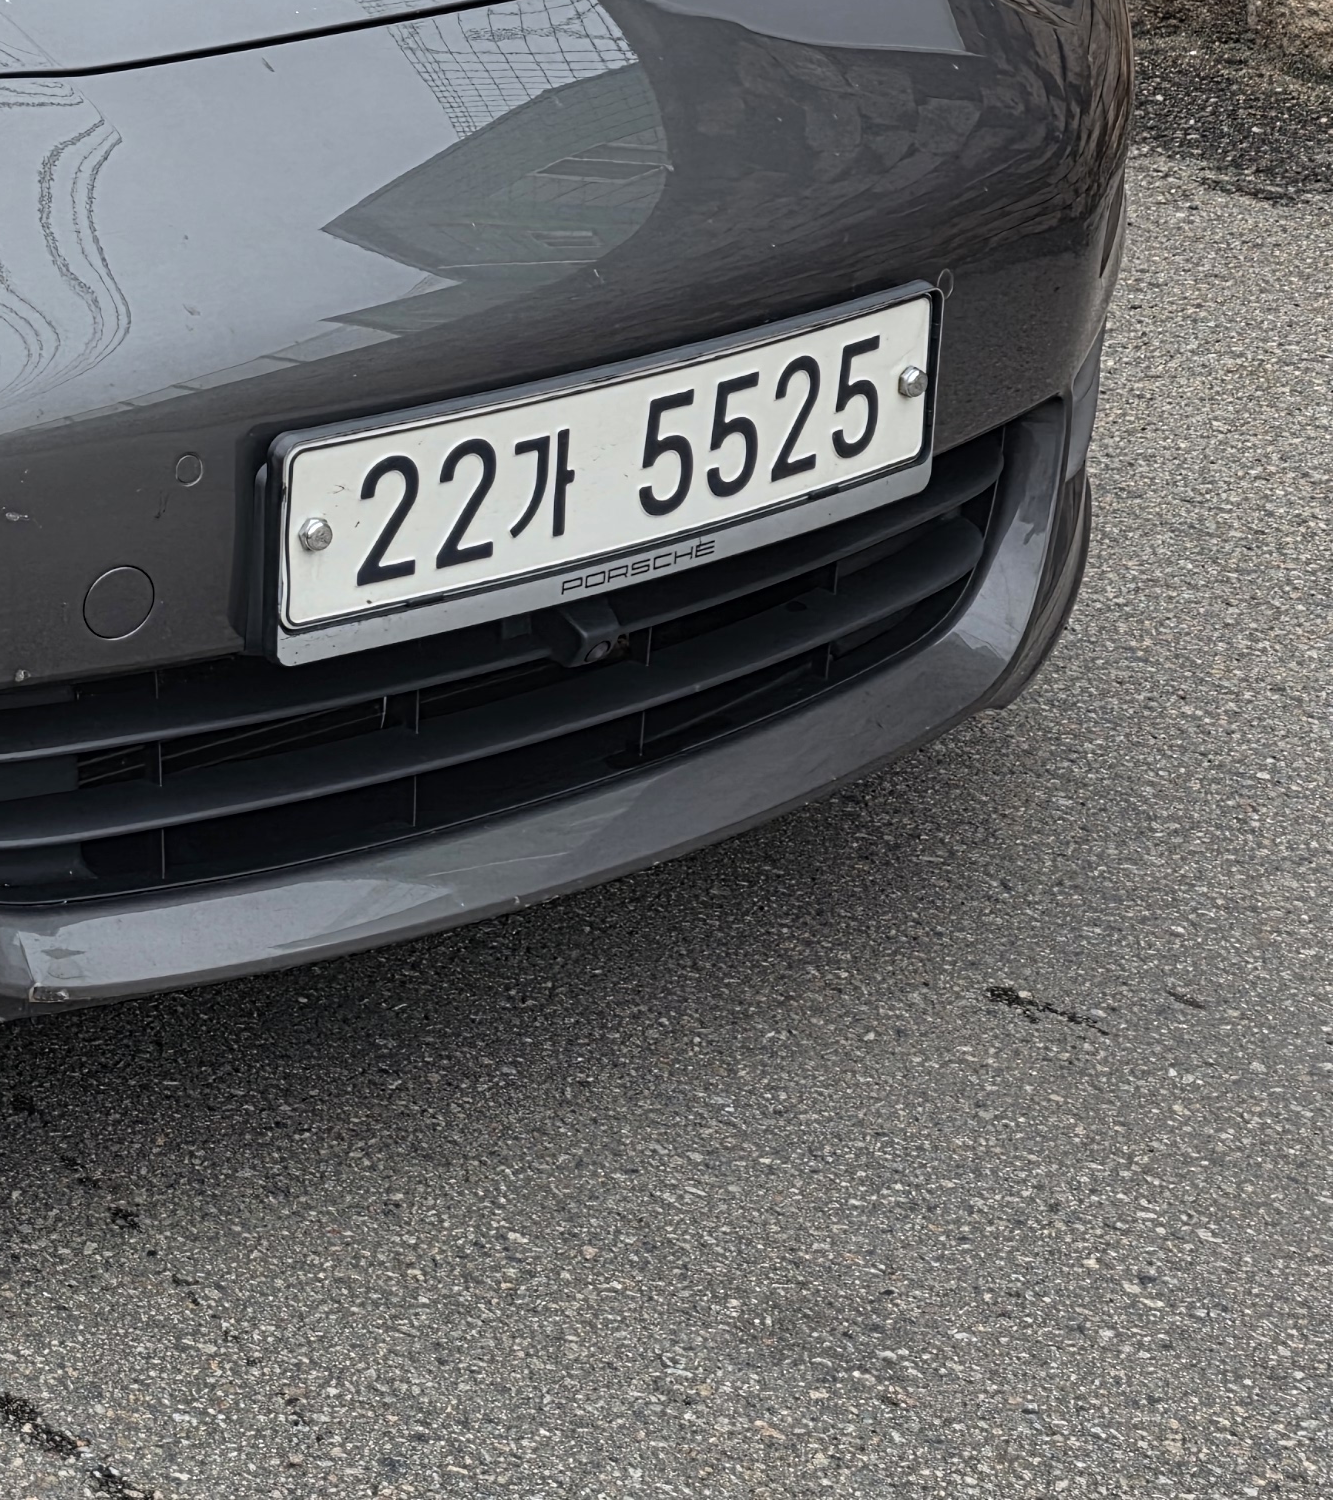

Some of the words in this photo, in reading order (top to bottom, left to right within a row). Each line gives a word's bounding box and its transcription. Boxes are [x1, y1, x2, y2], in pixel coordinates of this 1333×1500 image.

[356, 427, 576, 587] 22가
[637, 334, 881, 517] 5525
[561, 539, 716, 595] PORSCHE
